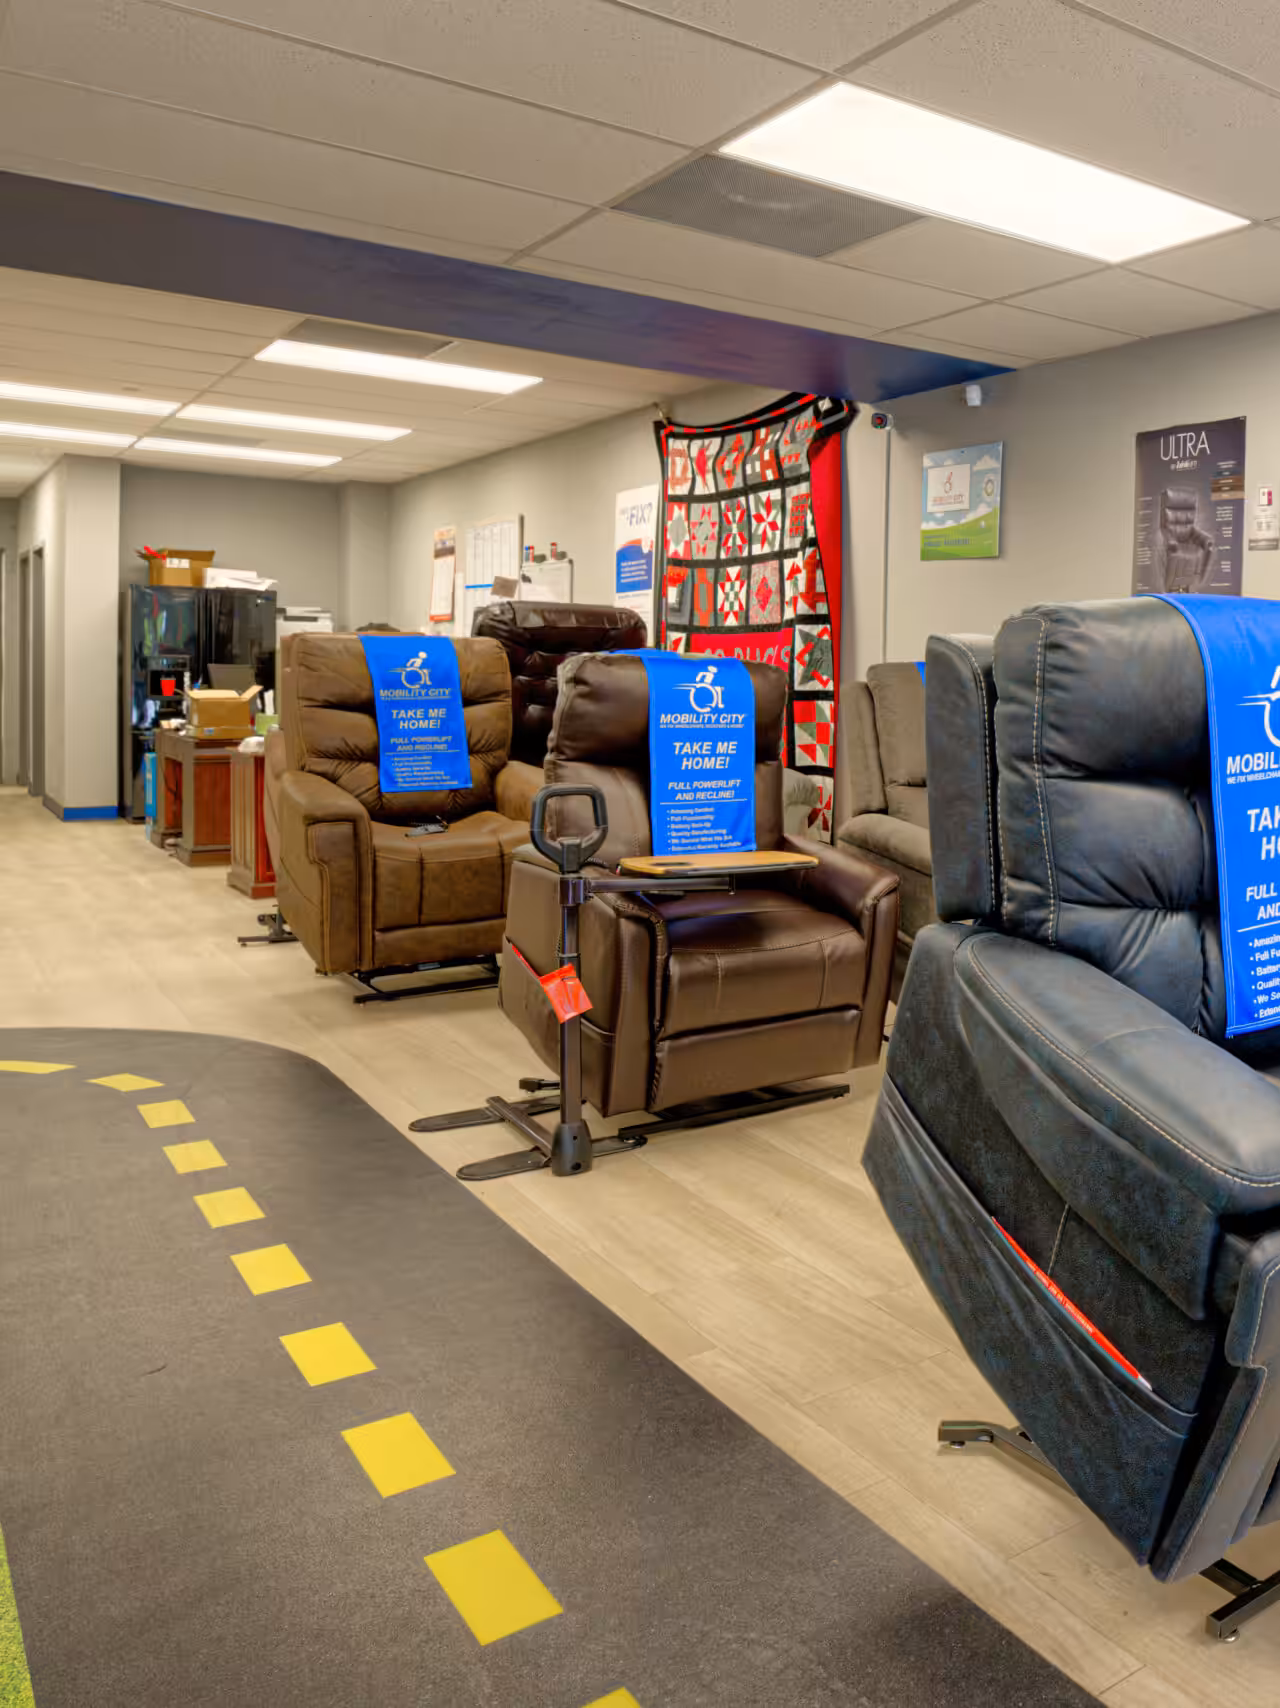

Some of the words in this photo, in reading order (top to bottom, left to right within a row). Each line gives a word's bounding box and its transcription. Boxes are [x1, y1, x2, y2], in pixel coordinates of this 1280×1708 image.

[1160, 431, 1211, 460] ULTRA
[380, 688, 427, 697] MOBILITY
[428, 688, 450, 697] CITY
[392, 708, 424, 718] TAKE
[428, 708, 447, 718] ME
[660, 713, 718, 723] MOBILITY
[720, 713, 745, 723] CITY
[400, 719, 440, 729] HOME!
[673, 741, 712, 754] TAKE
[716, 741, 738, 754] ME
[681, 756, 730, 770] HOME!
[668, 781, 691, 790] FULL
[675, 792, 694, 800] AND
[1246, 882, 1277, 902] FULL
[1255, 950, 1270, 962] Full
[1256, 994, 1269, 1004] We
